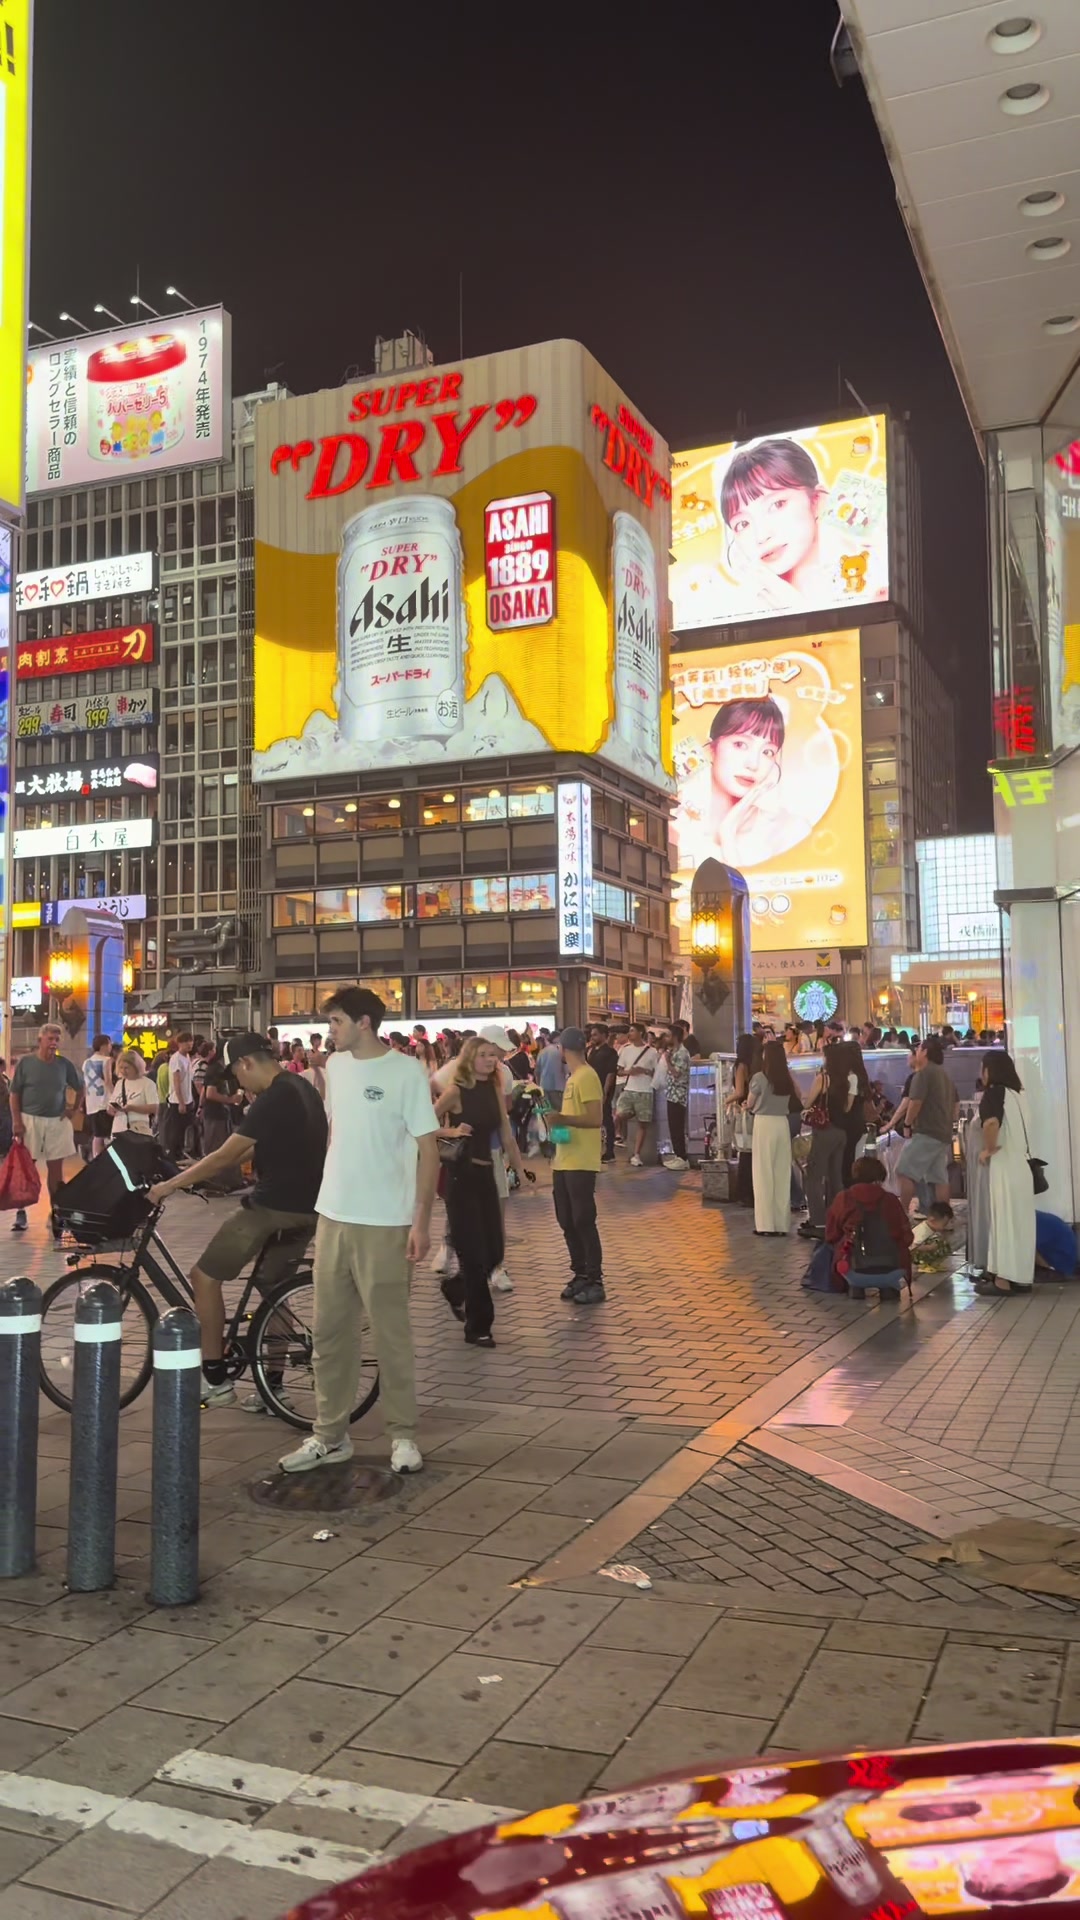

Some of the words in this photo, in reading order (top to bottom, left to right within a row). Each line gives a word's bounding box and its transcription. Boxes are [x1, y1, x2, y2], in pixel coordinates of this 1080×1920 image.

[63, 348, 77, 446] 実績と信頼の
[195, 319, 211, 439] 1974年発売
[348, 371, 464, 423] SUPER
[47, 352, 61, 481] ロングセラー商品
[618, 404, 654, 455] SUPER
[487, 503, 549, 544] ASAHI
[381, 542, 418, 556] SUPER
[504, 539, 533, 554] since
[94, 561, 144, 579] しゃぶしゃぶ
[488, 549, 549, 588] 1889
[349, 576, 449, 638] Asahi
[489, 586, 549, 624] OSAKA
[617, 591, 656, 657] Asahi
[18, 646, 69, 669] 肉割烹
[121, 628, 147, 660] 刀
[387, 634, 413, 655] 生
[632, 649, 643, 671] 生
[371, 668, 431, 687] スーパードライ
[17, 714, 41, 737] 299
[85, 707, 109, 729] 199
[50, 702, 77, 725] 寿司
[117, 695, 147, 716] 串カツ
[386, 707, 414, 719] 生ビール
[26, 770, 83, 796] 大牧場
[66, 827, 129, 851] 白木屋
[562, 871, 580, 949] かに道楽
